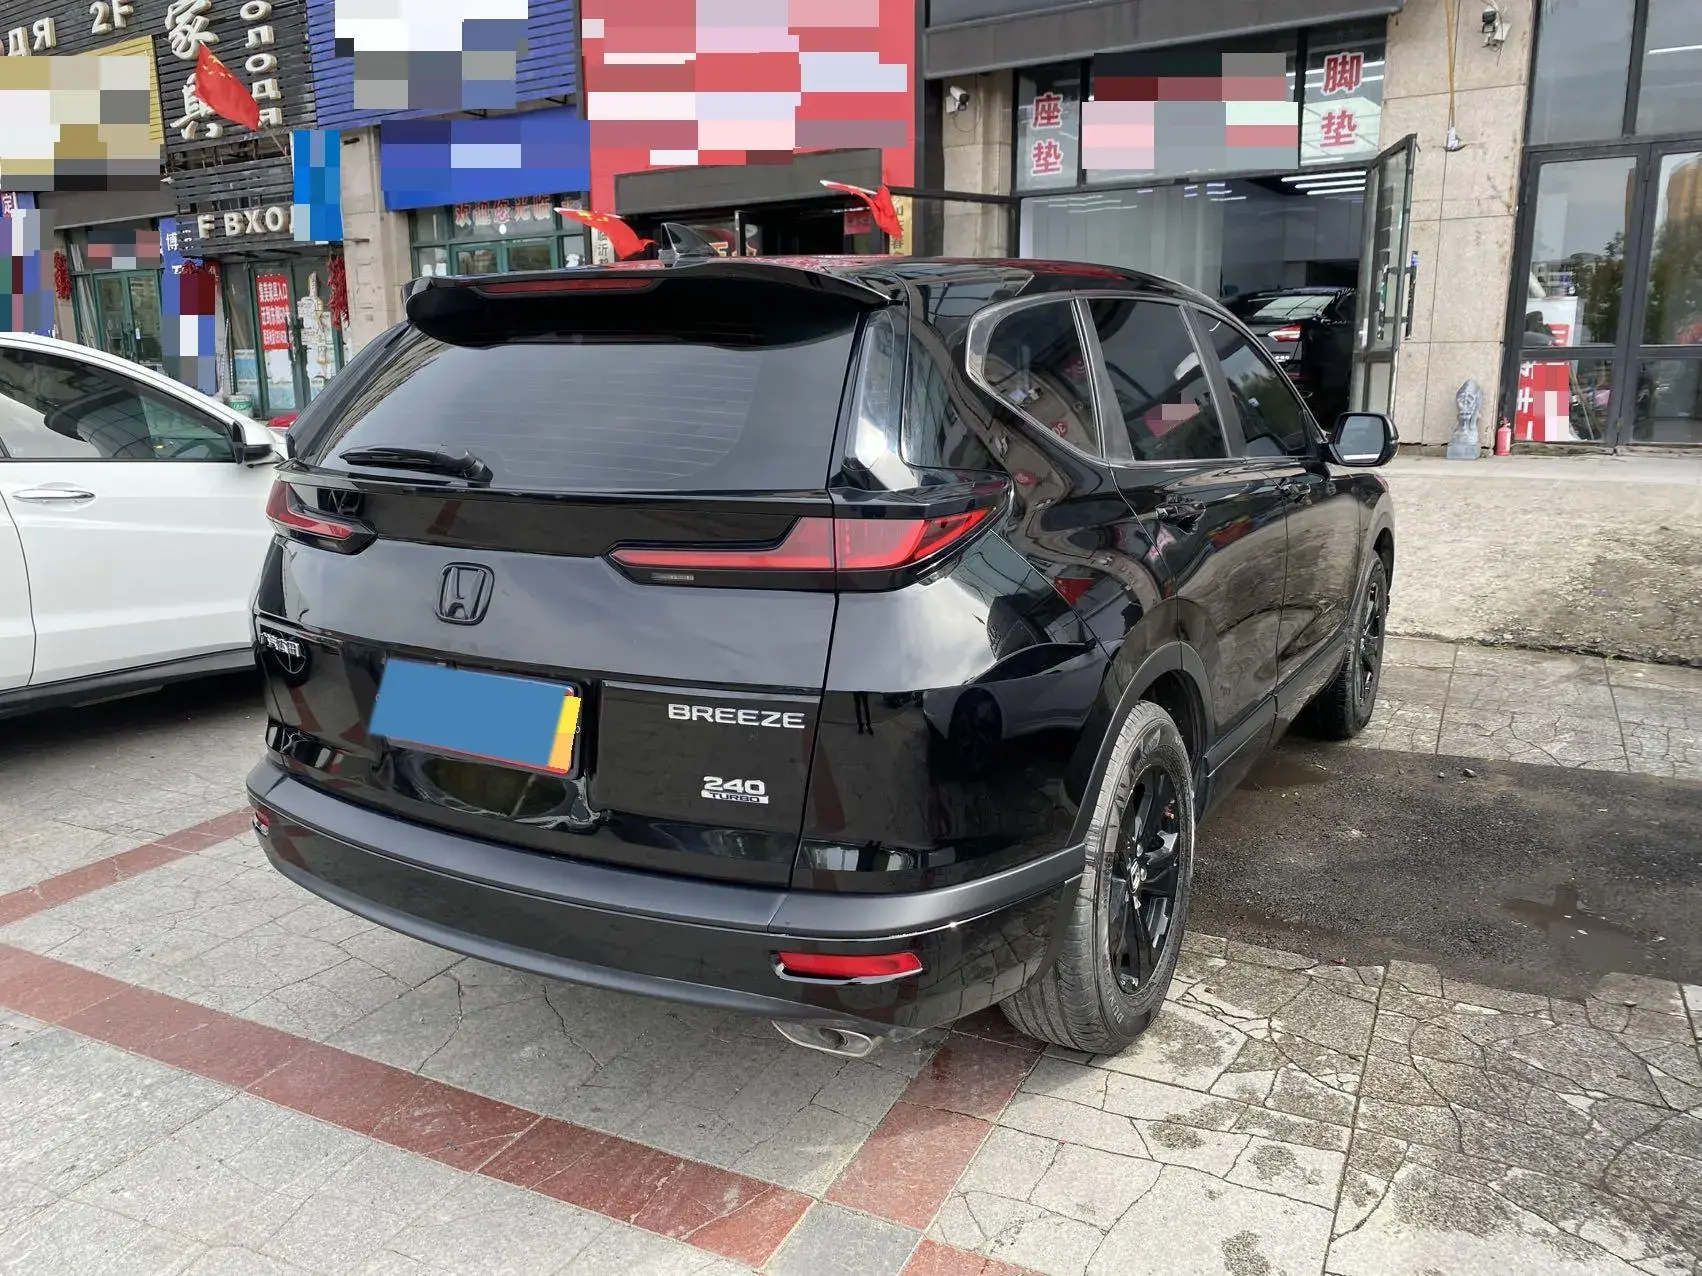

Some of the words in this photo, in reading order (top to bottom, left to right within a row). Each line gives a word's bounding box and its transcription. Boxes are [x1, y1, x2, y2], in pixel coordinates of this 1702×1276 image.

[89, 0, 134, 35] 2F
[0, 17, 57, 56] ДЯ
[1320, 51, 1364, 148] 脚垫
[1031, 92, 1063, 176] 座垫
[224, 205, 294, 237] ВХО
[668, 703, 805, 729] BREEZE
[703, 776, 765, 795] 240
[709, 792, 761, 803] TURBO
